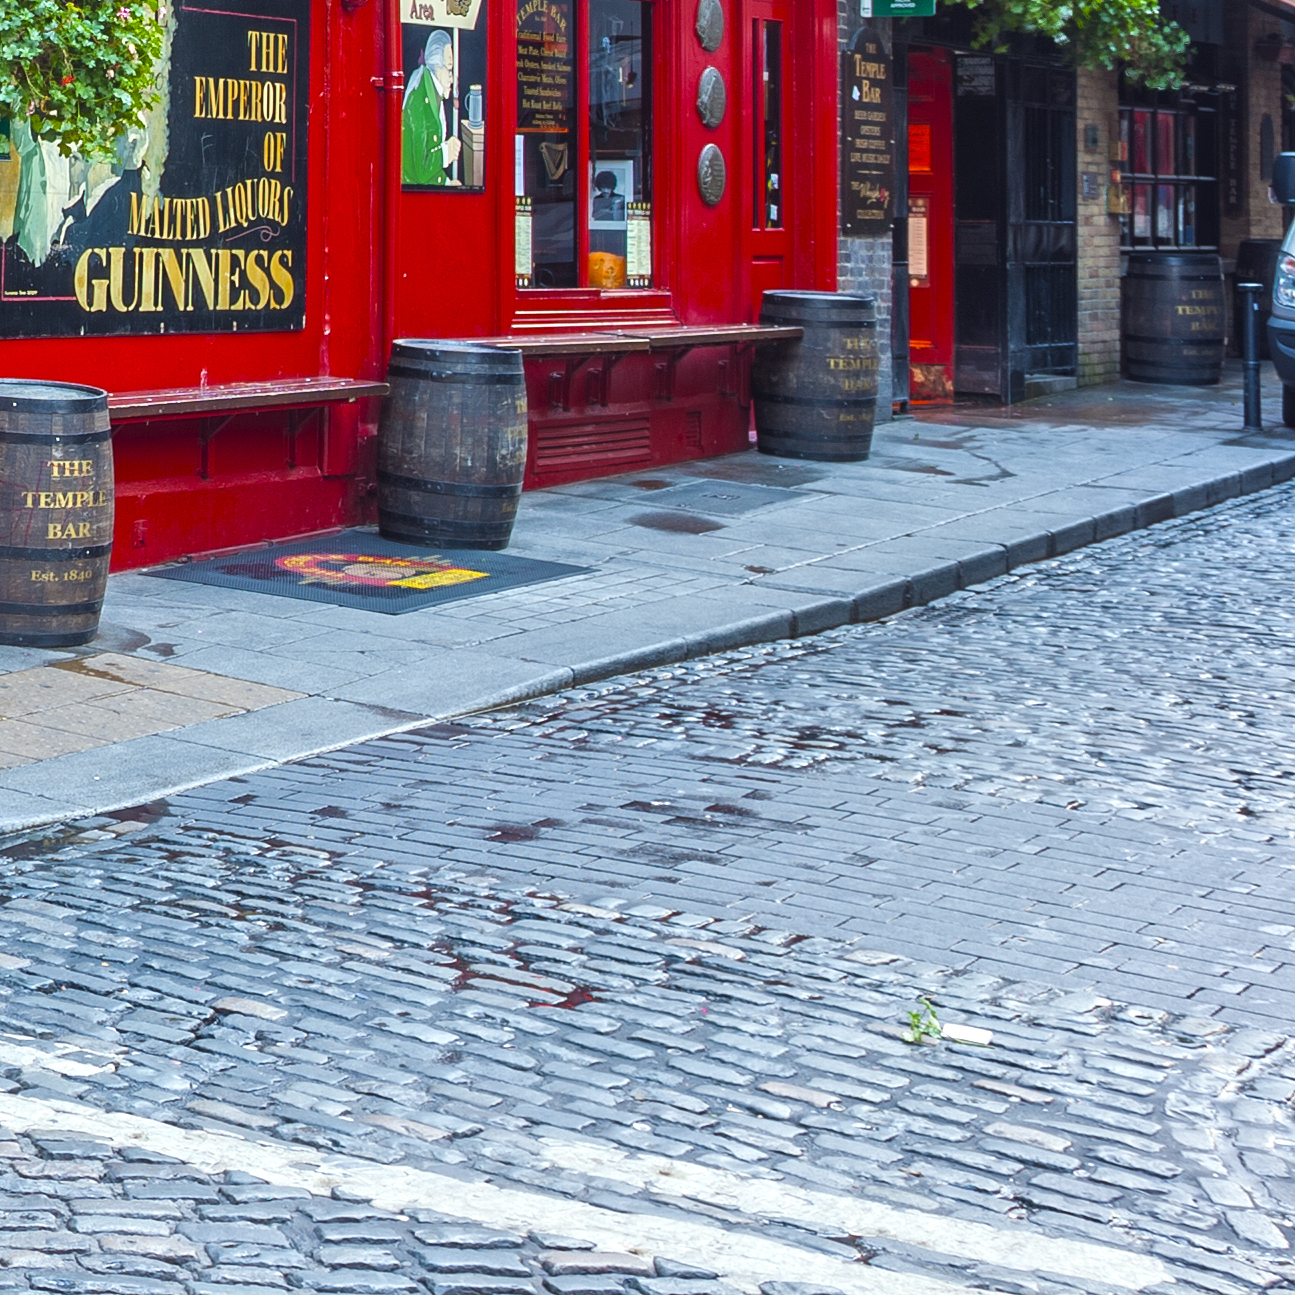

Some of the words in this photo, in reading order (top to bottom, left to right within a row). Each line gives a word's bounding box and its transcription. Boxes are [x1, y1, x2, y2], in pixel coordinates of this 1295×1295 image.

[550, 5, 568, 32] BAR
[248, 29, 289, 75] THE
[854, 54, 887, 80] TEMPLE
[193, 75, 287, 125] EMPEROR
[861, 79, 882, 104] BAR
[262, 132, 287, 173] OF
[127, 191, 211, 241] MALTED
[214, 176, 295, 234] LIQUORS
[73, 246, 296, 313] GUINNESS
[46, 459, 94, 478] THE
[20, 490, 108, 509] TEMPLE
[45, 521, 93, 540] BAR
[30, 569, 59, 582] Est.
[63, 569, 94, 583] 1840
